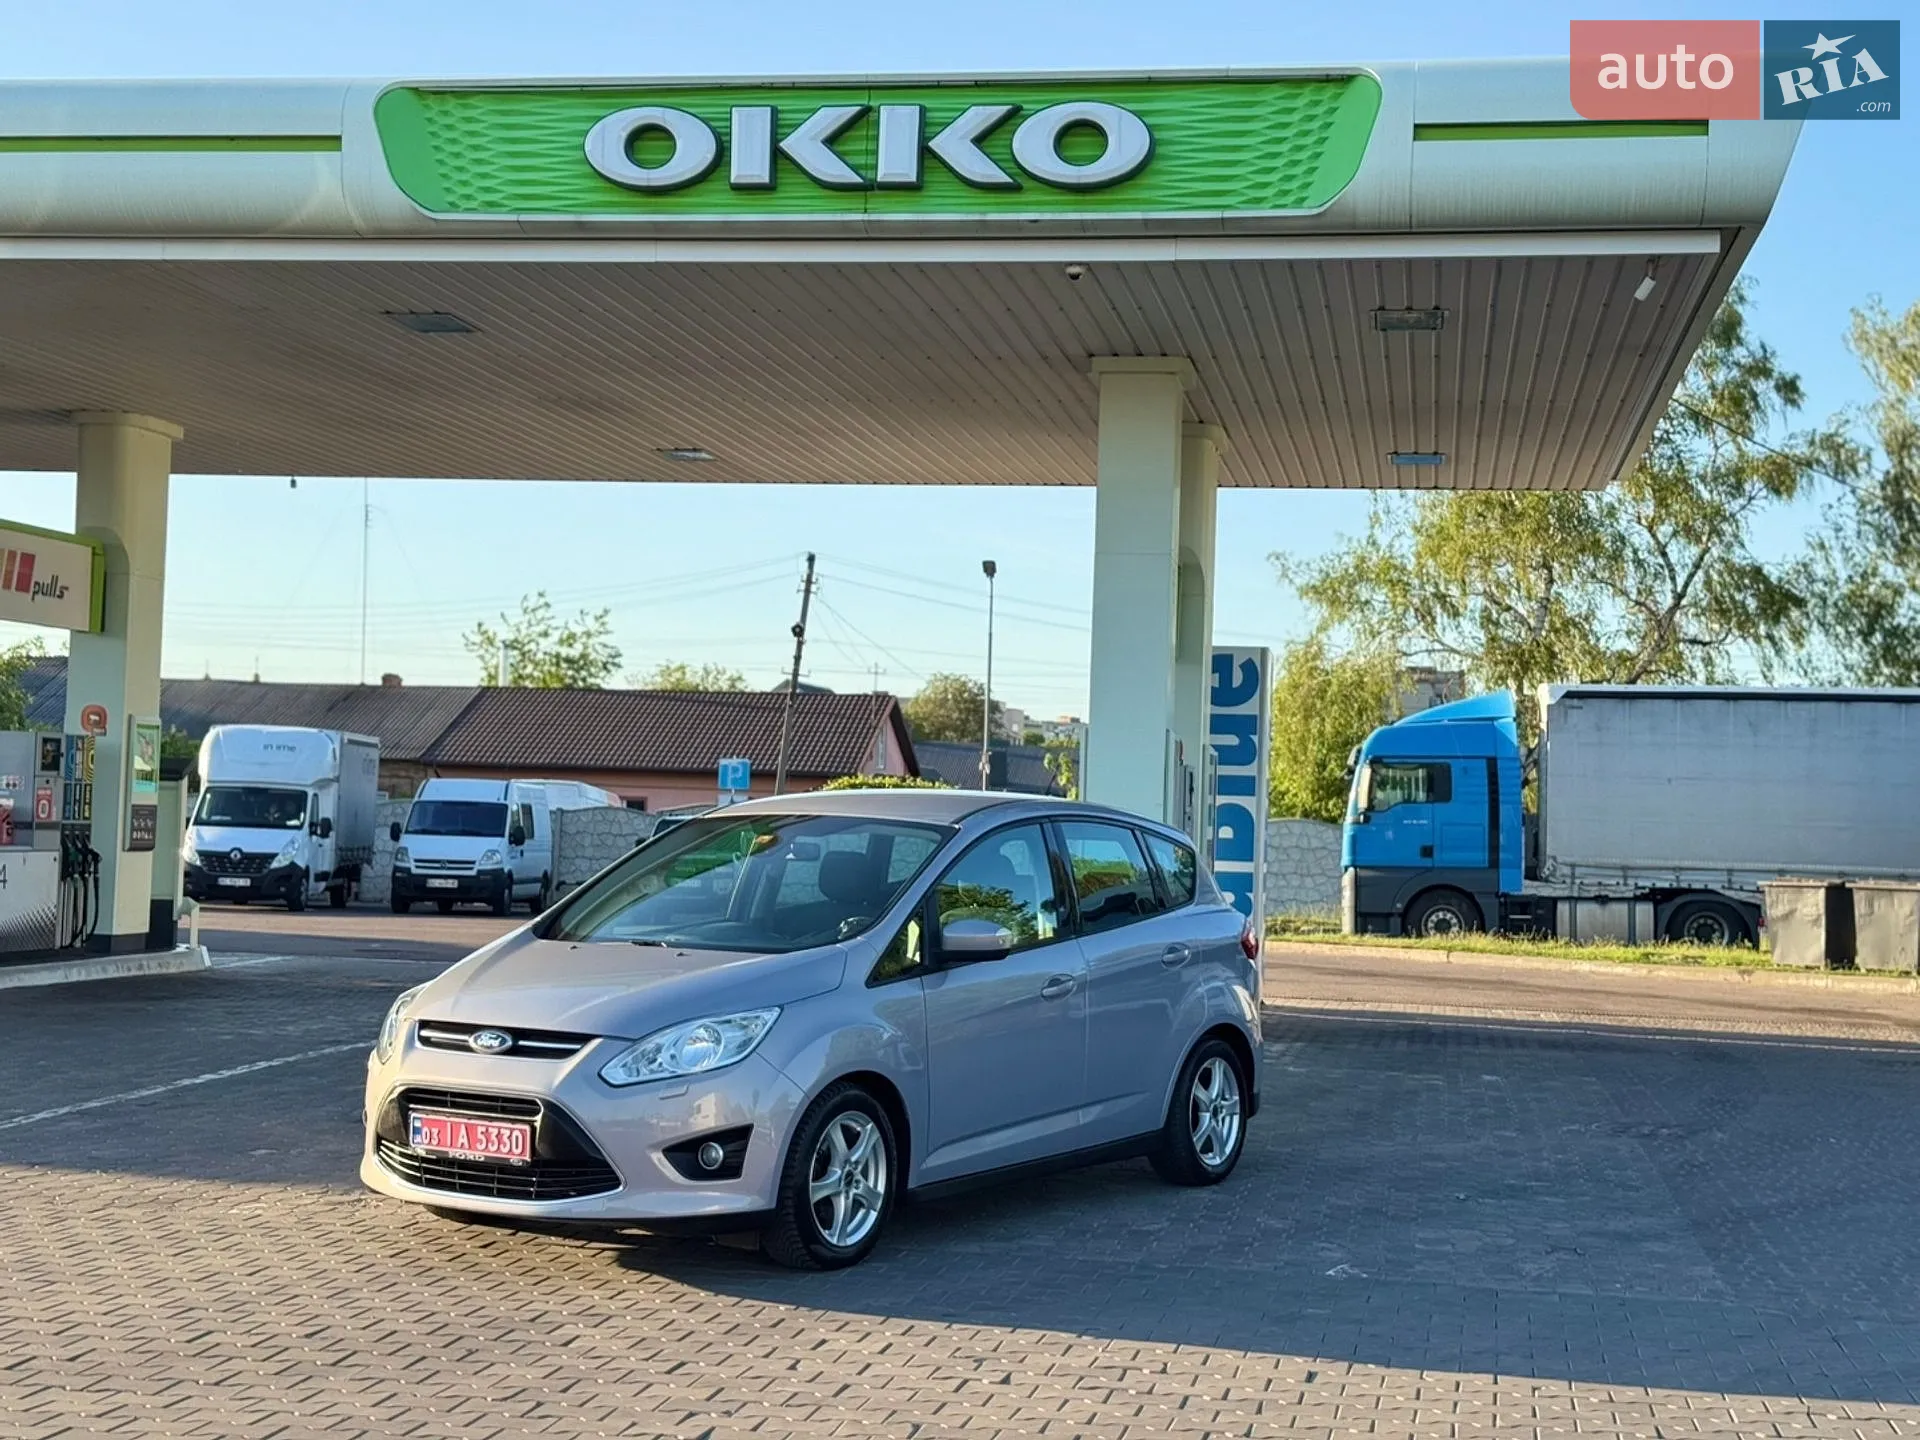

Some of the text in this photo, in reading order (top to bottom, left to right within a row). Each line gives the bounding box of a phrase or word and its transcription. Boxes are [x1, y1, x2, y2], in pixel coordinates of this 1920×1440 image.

[582, 100, 1156, 191] OKKO
[31, 574, 70, 602] pulls
[728, 763, 743, 787] P
[422, 1126, 440, 1145] 03
[476, 1126, 523, 1155] 5330
[448, 1150, 485, 1161] FORD
